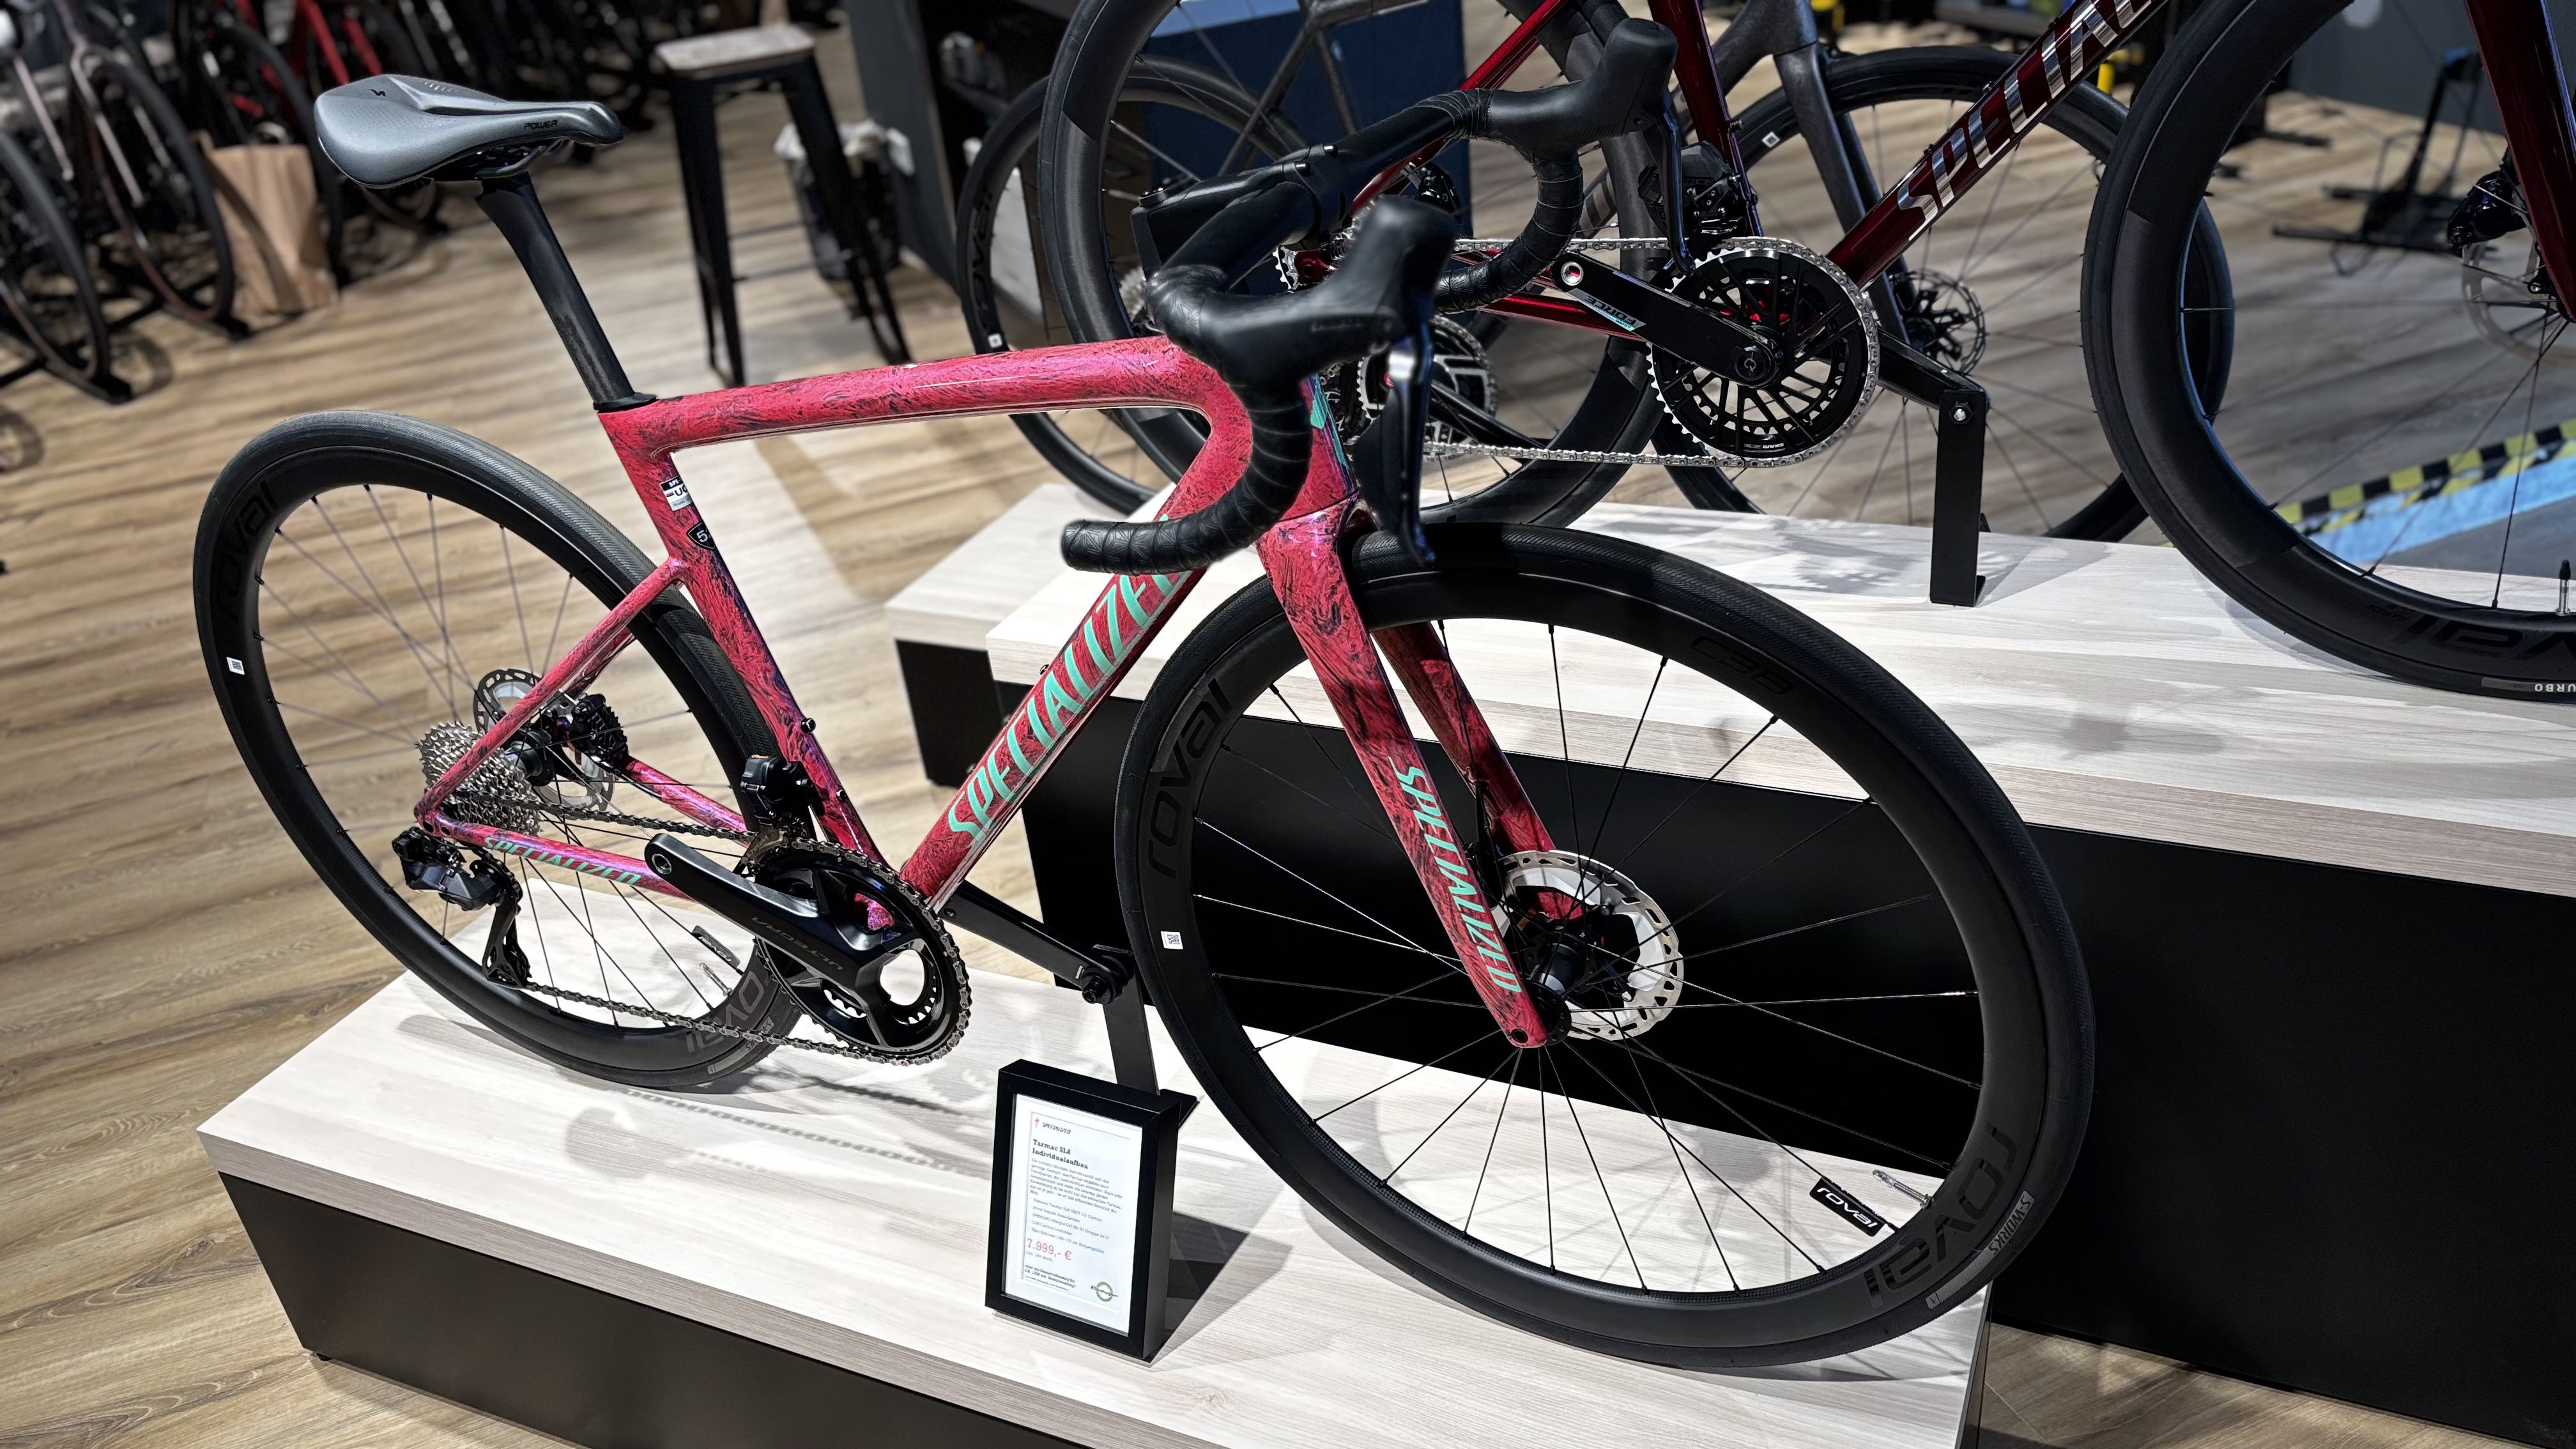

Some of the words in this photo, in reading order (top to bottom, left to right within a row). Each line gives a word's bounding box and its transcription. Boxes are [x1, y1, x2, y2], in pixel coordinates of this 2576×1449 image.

[523, 119, 558, 130] POWER
[1583, 295, 1637, 326] FORCE
[1690, 636, 1795, 696] C38
[1147, 678, 1232, 880] roval
[484, 836, 643, 886] SPECIALIZED
[1388, 755, 1522, 994] SPECIALIZED
[696, 934, 733, 963] roval
[751, 916, 843, 971] ULTEGRA
[685, 970, 769, 1054] oval
[1032, 1139, 1058, 1151] Tarmac
[1059, 1146, 1071, 1154] SL8
[1042, 1122, 1071, 1134] SPECIALIZED
[1032, 1148, 1088, 1169] Individualaufbau
[1816, 1186, 1878, 1229] roval
[1862, 1122, 2018, 1308] roval
[1988, 1193, 2033, 1257] S-WORKS
[1027, 1238, 1061, 1259] 7.999,-
[1064, 1250, 1071, 1261] €
